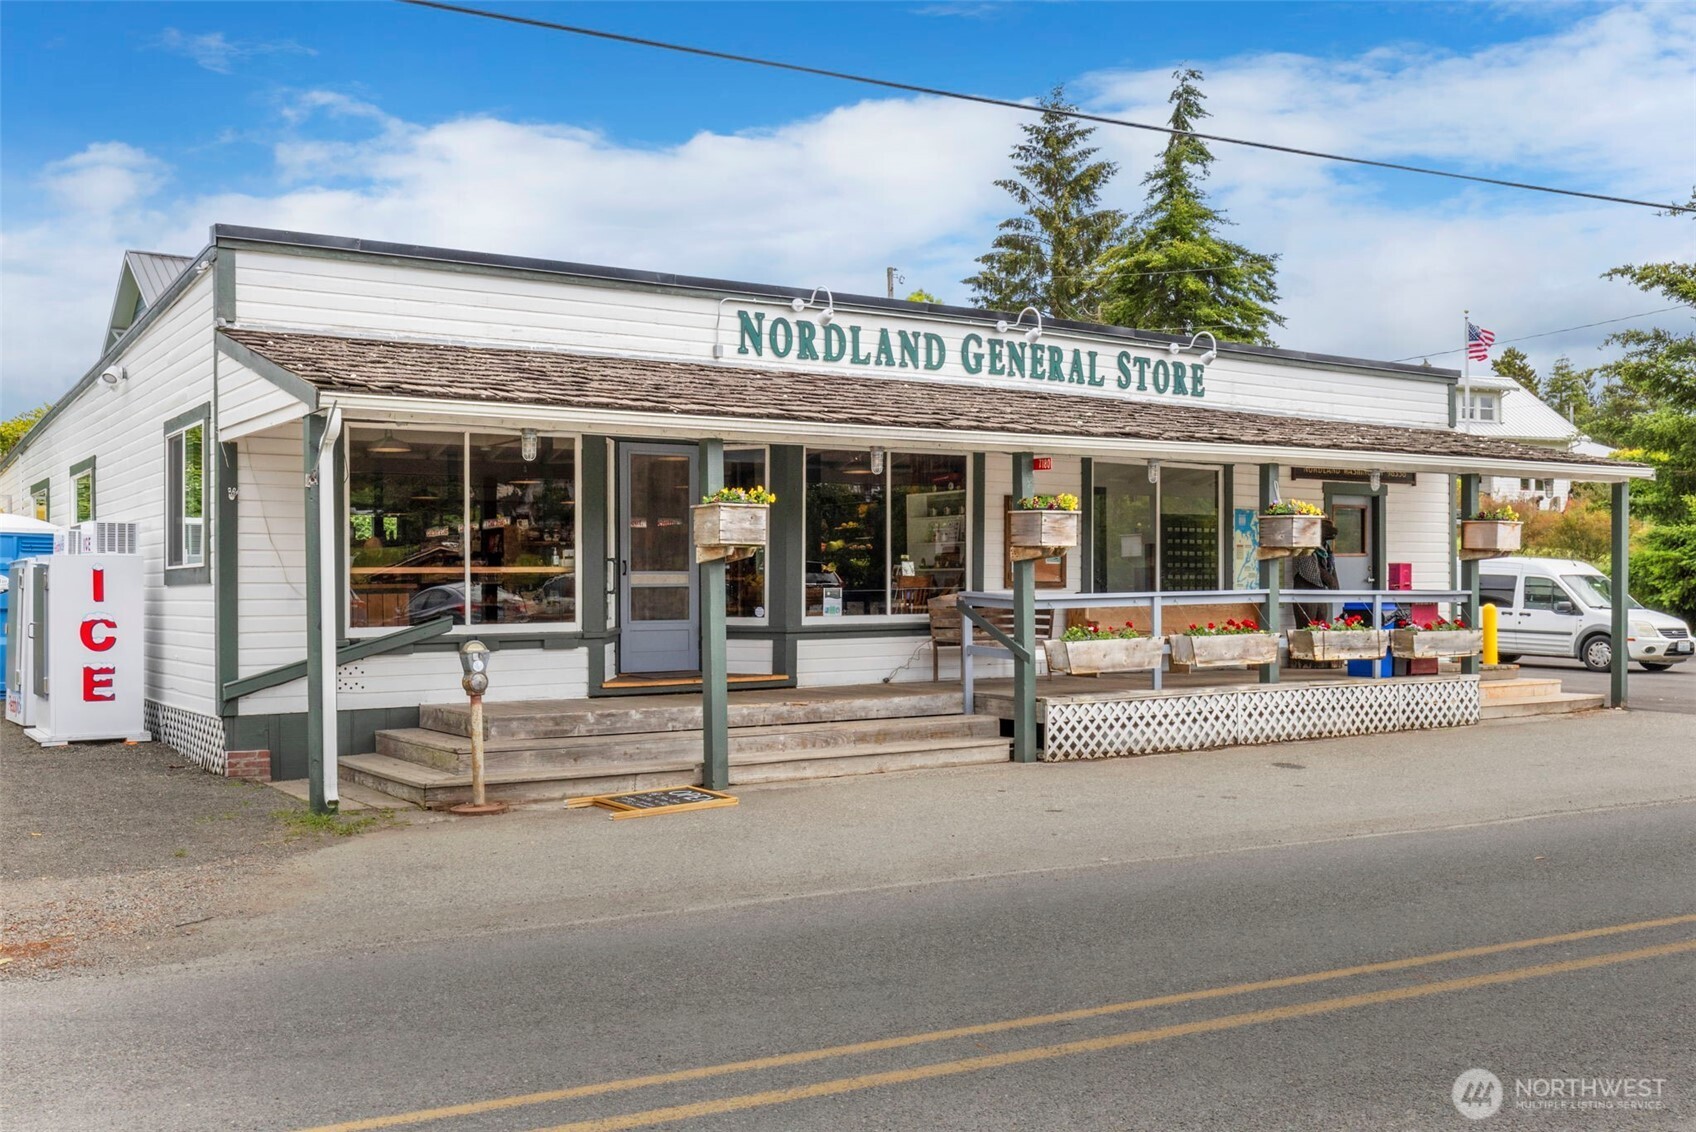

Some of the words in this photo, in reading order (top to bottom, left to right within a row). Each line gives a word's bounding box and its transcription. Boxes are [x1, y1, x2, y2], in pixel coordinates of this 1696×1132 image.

[737, 309, 947, 371] NORDLAND
[961, 333, 1105, 388] GENERAL
[1117, 350, 1206, 398] STORE
[79, 563, 118, 702] ICE
